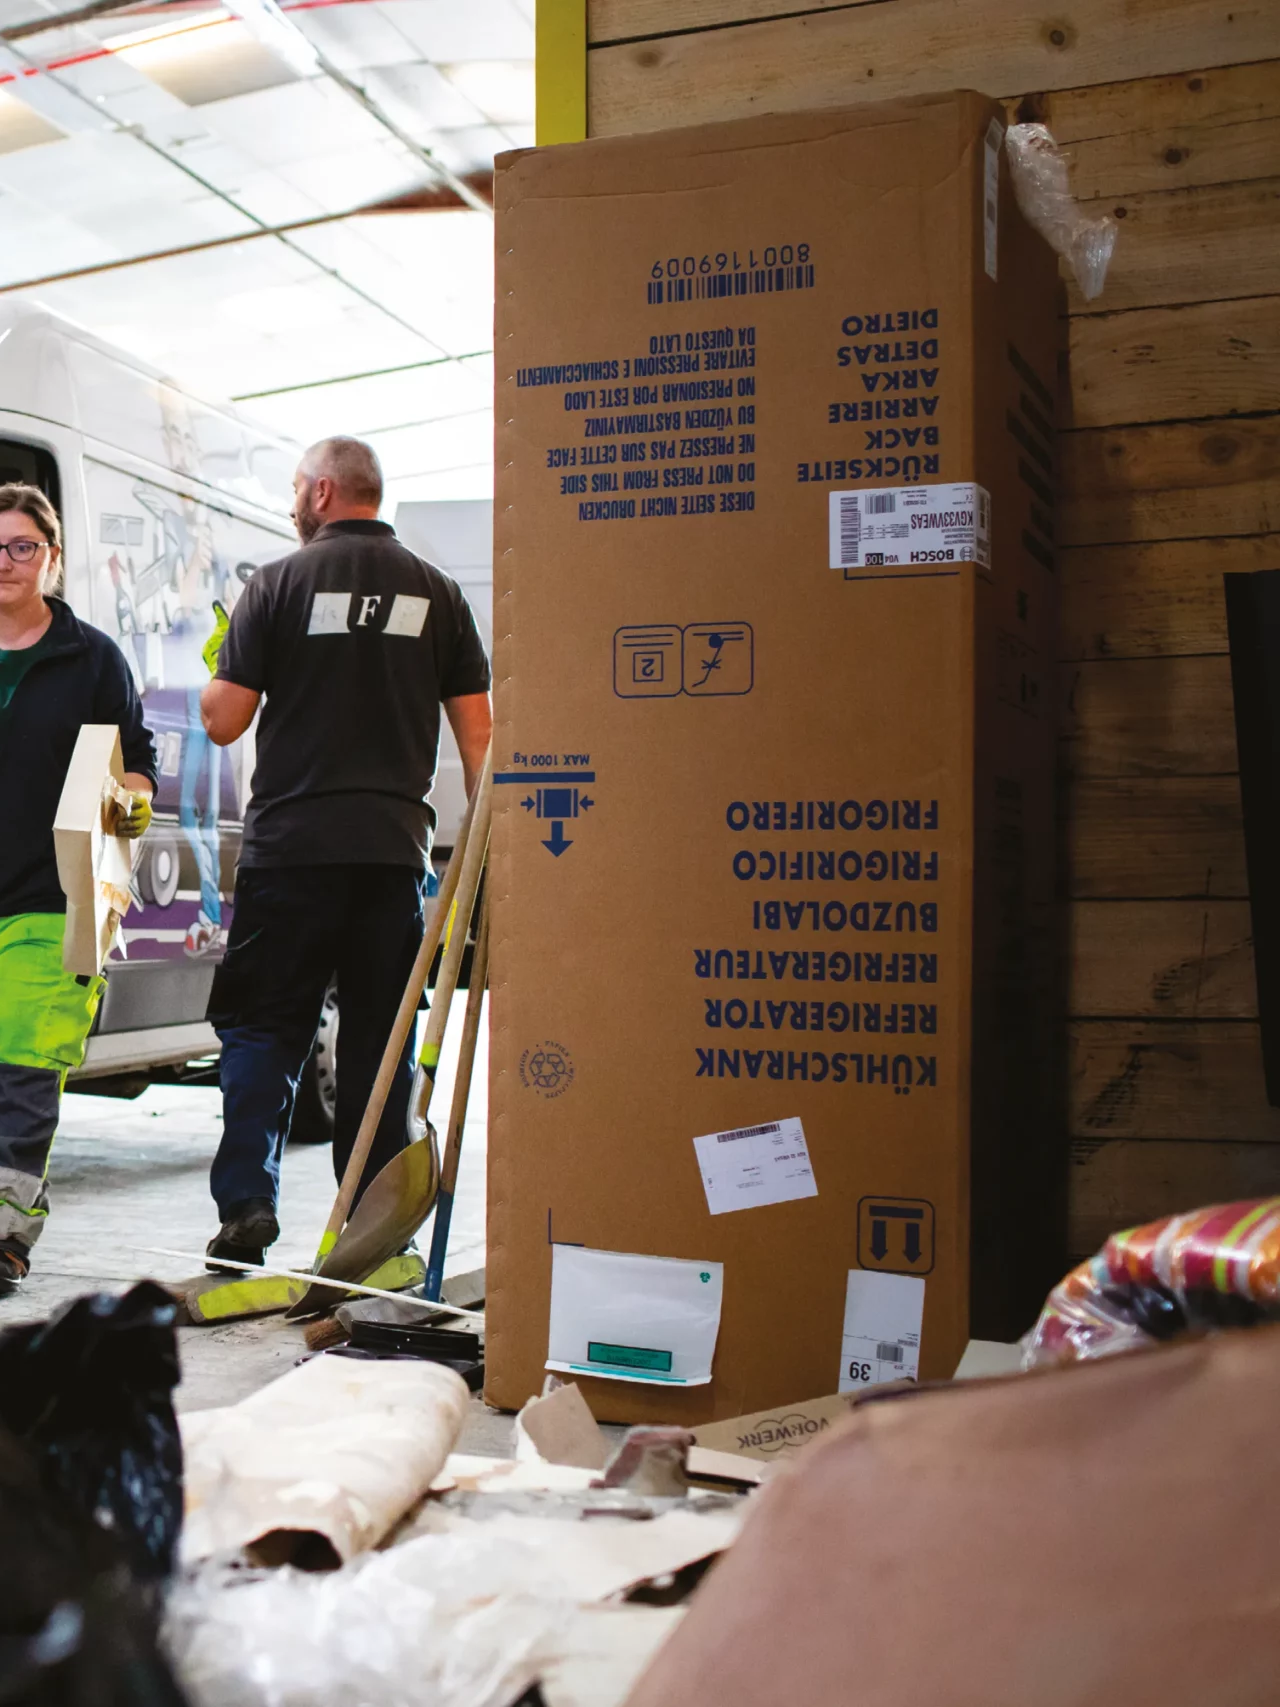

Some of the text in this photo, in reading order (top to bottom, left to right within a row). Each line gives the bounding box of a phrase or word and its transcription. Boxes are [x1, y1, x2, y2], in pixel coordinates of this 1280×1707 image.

[650, 243, 811, 279] 8001169009
[842, 309, 938, 336] DIETRO
[649, 327, 756, 354] DA QUESTO LATO
[837, 339, 938, 367] DETRAS
[517, 347, 755, 387] EVITARE PRESSIONI E SCHIACCIAMENTI
[862, 368, 938, 392] ARKA
[564, 376, 755, 411] NO PRESIONAR POR ESTE LADO
[584, 405, 755, 438] BU YÜZDEN BASTIRMAYINIZ
[829, 396, 938, 424] ARRIERE
[547, 434, 755, 469] NE PRESSEZ PAS SUR CETTE FACE
[865, 426, 939, 450] BACK
[560, 462, 755, 495] DO NOT PRESS FROM THIS SIDE
[798, 454, 939, 482] RÜCKSEITE
[578, 491, 755, 520] DIESE SEITE NICHT DRUCKEN
[911, 511, 973, 529] KGV33VWEAS
[866, 554, 883, 564] 100
[910, 549, 954, 562] BOSCH
[641, 659, 655, 677] 2
[513, 752, 590, 766] MAX 1000 kg
[726, 800, 938, 831] FRIGORIFERO
[732, 850, 938, 881] FRIGORIFICO
[753, 901, 937, 932] BUZDOLABI
[694, 949, 937, 983] REFRIGERATEUR
[705, 998, 937, 1034] REFRIGERATOR
[696, 1048, 936, 1094] KÜHLSCHRANK
[850, 1361, 871, 1381] 39
[736, 1417, 829, 1449] VORWERK
